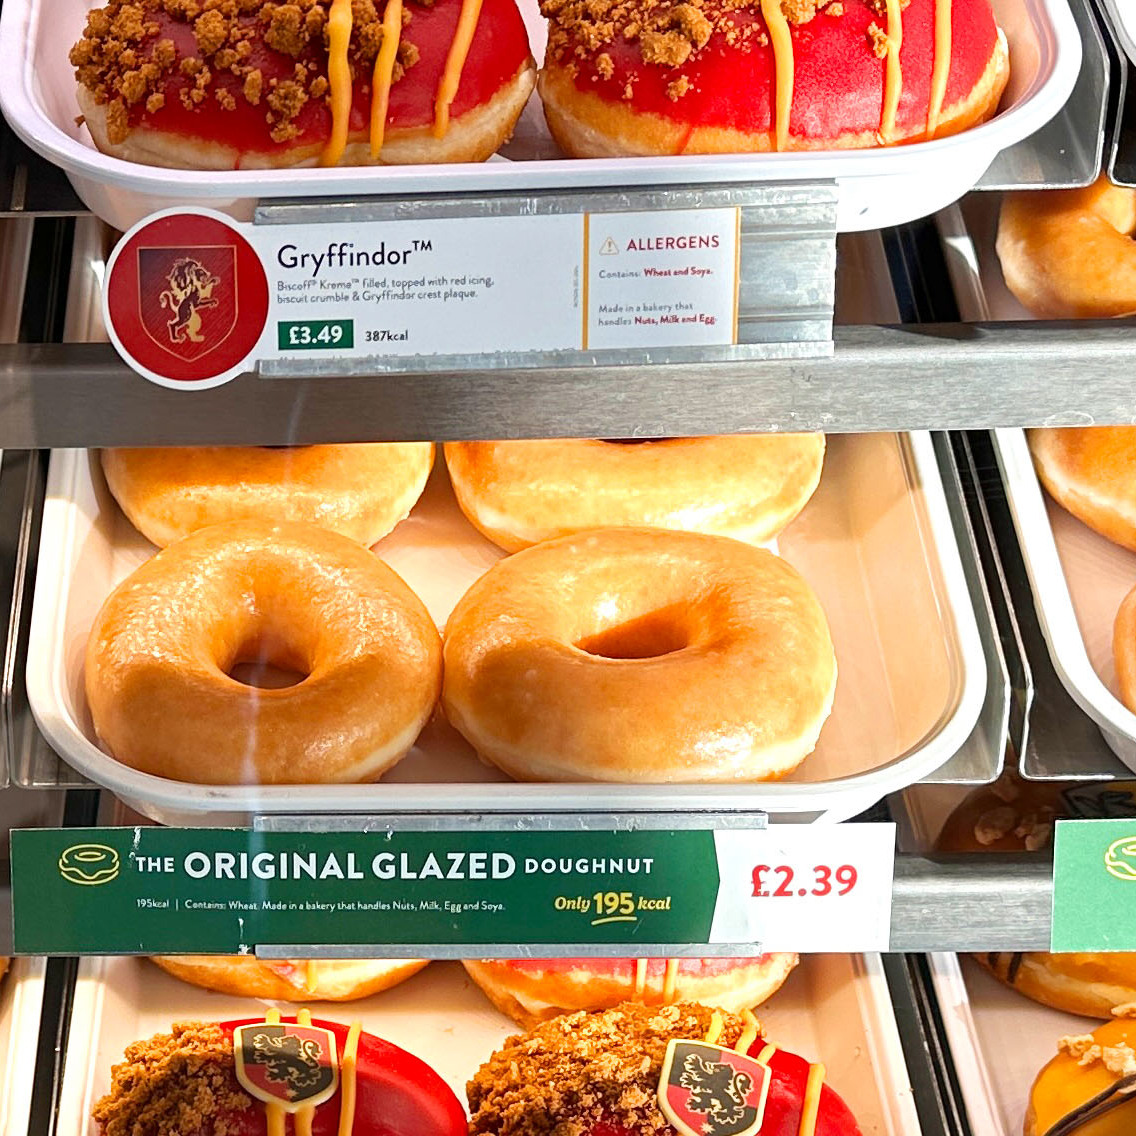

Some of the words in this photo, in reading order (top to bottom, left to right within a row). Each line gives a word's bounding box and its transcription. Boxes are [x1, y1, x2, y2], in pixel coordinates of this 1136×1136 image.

[627, 235, 719, 251] ALLERGENS
[644, 267, 671, 277] Wheat
[673, 267, 688, 275] and
[392, 276, 425, 291] topped
[428, 276, 447, 286] with
[450, 275, 466, 285] red
[277, 295, 307, 304] biscuit
[310, 292, 349, 302] crumble
[352, 291, 359, 301] &
[363, 290, 415, 304] Gryffindor
[417, 291, 441, 299] crest
[599, 304, 623, 313] Made
[625, 304, 634, 312] in
[643, 302, 672, 313] bakery
[675, 301, 693, 310] that
[598, 317, 631, 326] handles
[660, 315, 679, 324] Milk
[682, 314, 696, 322] and
[289, 324, 343, 345] £3.49
[365, 330, 408, 342] 387kcal
[137, 857, 175, 873] THE
[184, 851, 364, 880] ORIGINAL
[372, 852, 516, 880] GLAZED
[525, 857, 654, 875] DOUGHNUT
[751, 865, 858, 898] £2.39
[136, 898, 169, 908] 195kcal
[262, 901, 287, 910] Made
[289, 901, 297, 910] in
[306, 901, 335, 912] bakery
[337, 901, 356, 910] that
[357, 901, 390, 910] handles
[393, 901, 418, 912] Nuts,
[419, 901, 442, 911] Milk,
[444, 901, 461, 913] Egg
[464, 901, 480, 910] and
[554, 895, 591, 913] Only
[593, 891, 634, 916] 195
[637, 895, 671, 911] kcal
